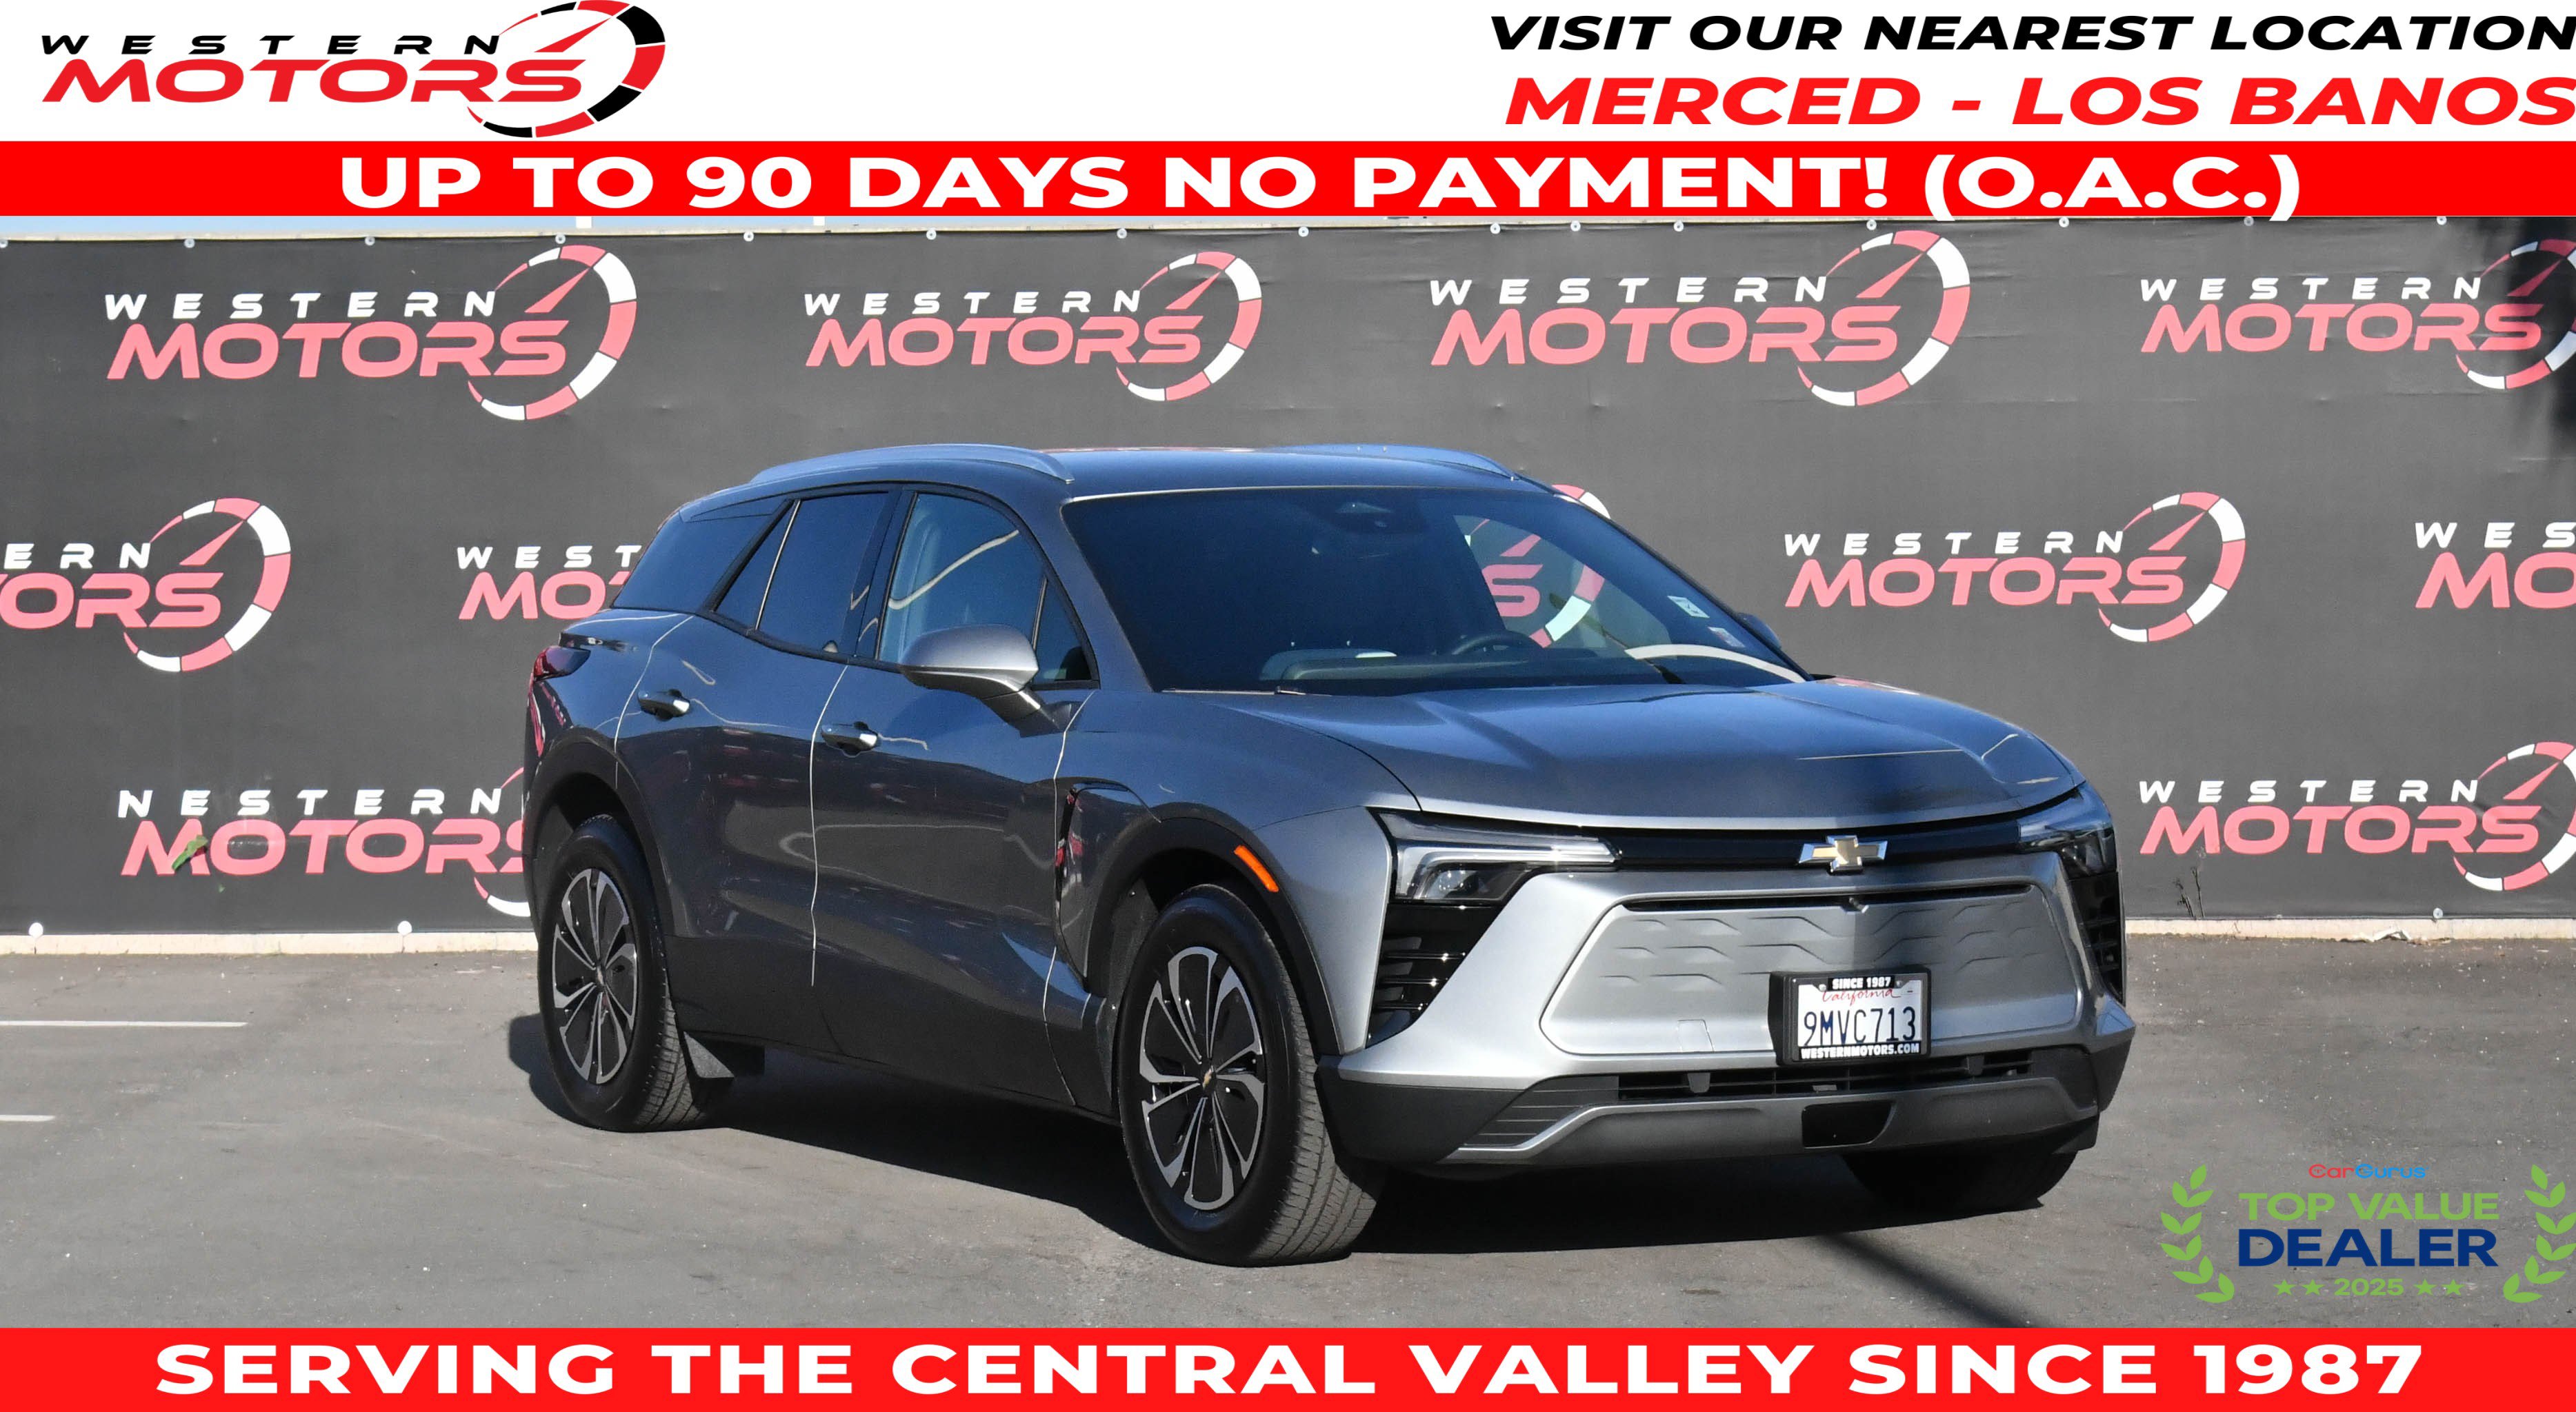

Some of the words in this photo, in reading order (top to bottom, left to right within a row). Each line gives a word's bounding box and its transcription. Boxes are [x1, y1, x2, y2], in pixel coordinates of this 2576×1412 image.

[105, 290, 496, 321] WESTERN
[804, 290, 1140, 316] WESTERN
[1430, 274, 1826, 306] WESTERN
[2140, 276, 2482, 303] WESTERN
[806, 314, 1204, 367] MOTORS
[1431, 305, 1901, 366] MOTORS
[2141, 302, 2543, 354] MOTORS
[107, 319, 570, 381] MOTORS
[1784, 530, 2123, 556] WESTERN
[1785, 556, 2186, 609] MOTORS
[0, 572, 224, 630] ORS
[2139, 779, 2479, 805] WESTERN
[2140, 804, 2542, 856] MOTORS
[1832, 978, 1864, 990] SINCE
[1866, 976, 1892, 988] 1987
[1804, 1007, 1916, 1047] 9MVC713
[1801, 1042, 1919, 1060] WESTERNMOTORS.COM
